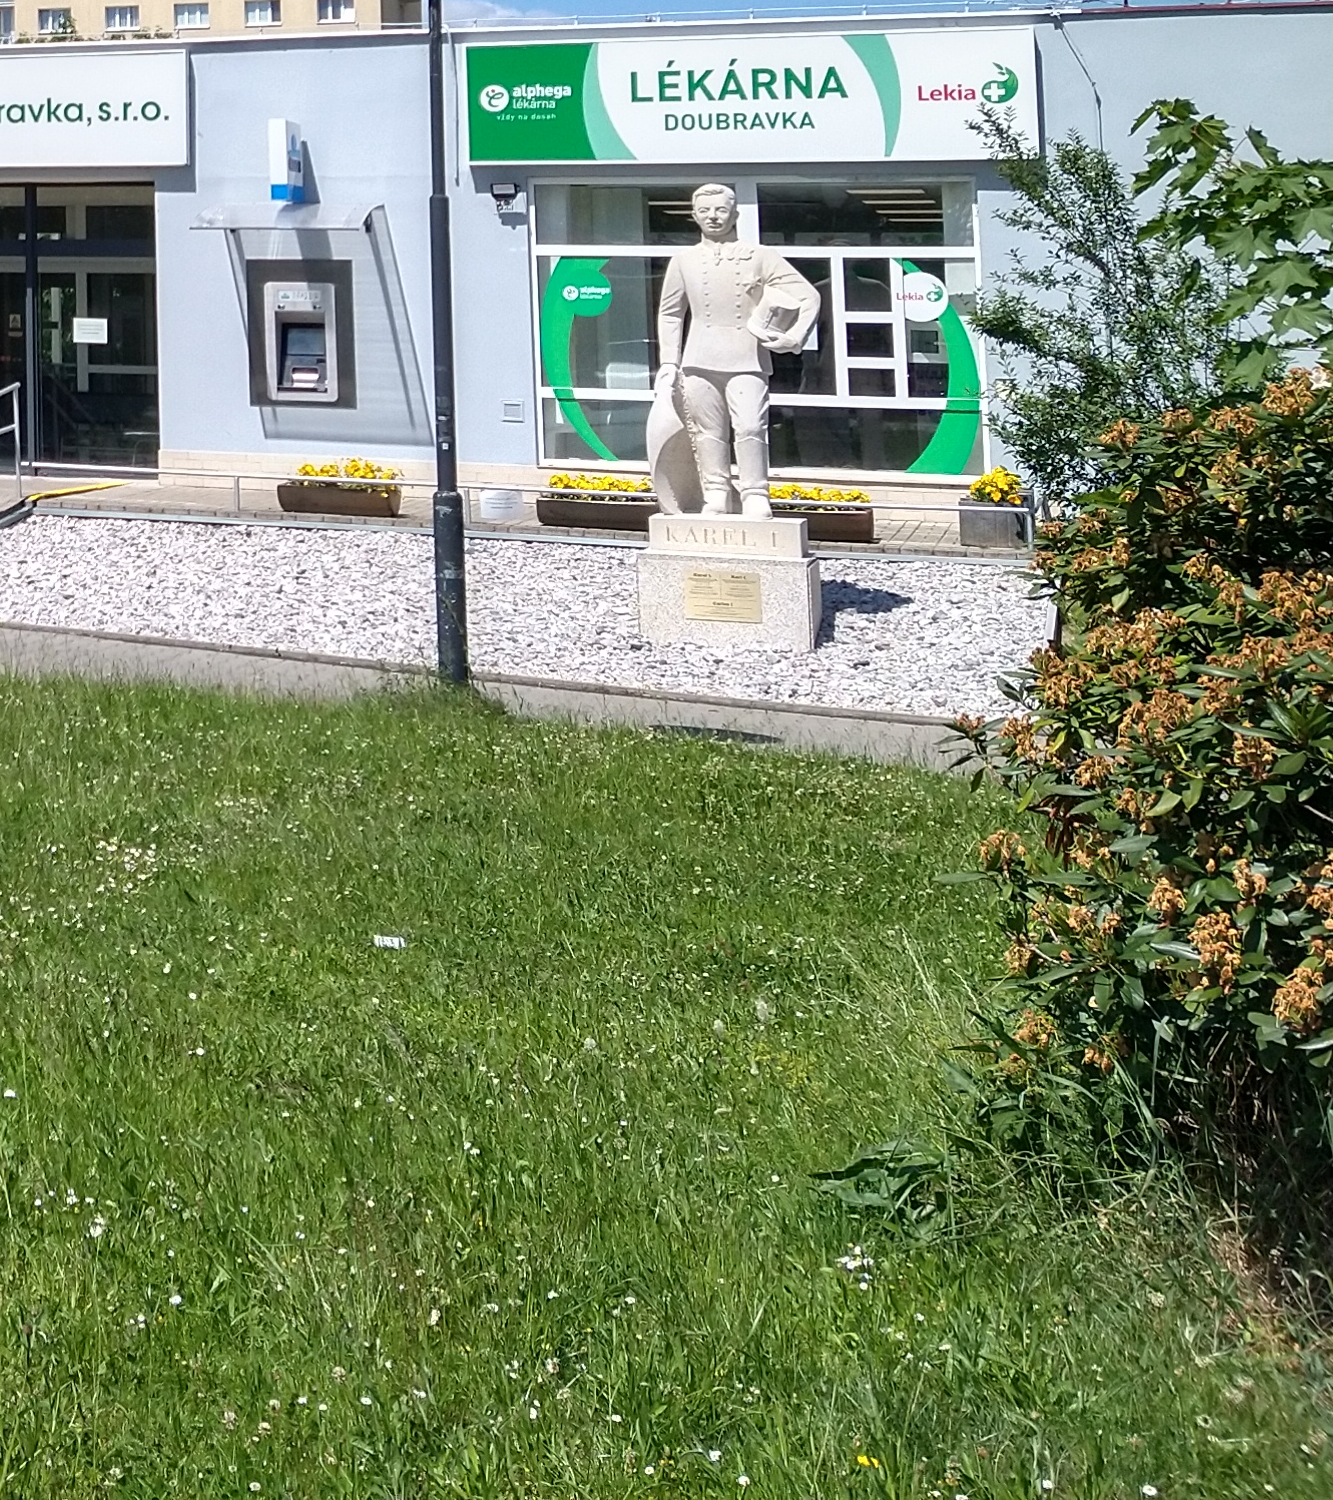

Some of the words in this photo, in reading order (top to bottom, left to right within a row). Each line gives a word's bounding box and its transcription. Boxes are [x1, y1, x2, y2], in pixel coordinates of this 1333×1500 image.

[630, 58, 849, 103] LÉKÁRNA
[512, 83, 572, 99] alphega
[917, 83, 976, 101] Lekia
[98, 99, 170, 122] s.r.o.
[512, 98, 556, 109] lékárna
[664, 111, 816, 131] DOUBRAVKA
[665, 525, 757, 548] KAREL
